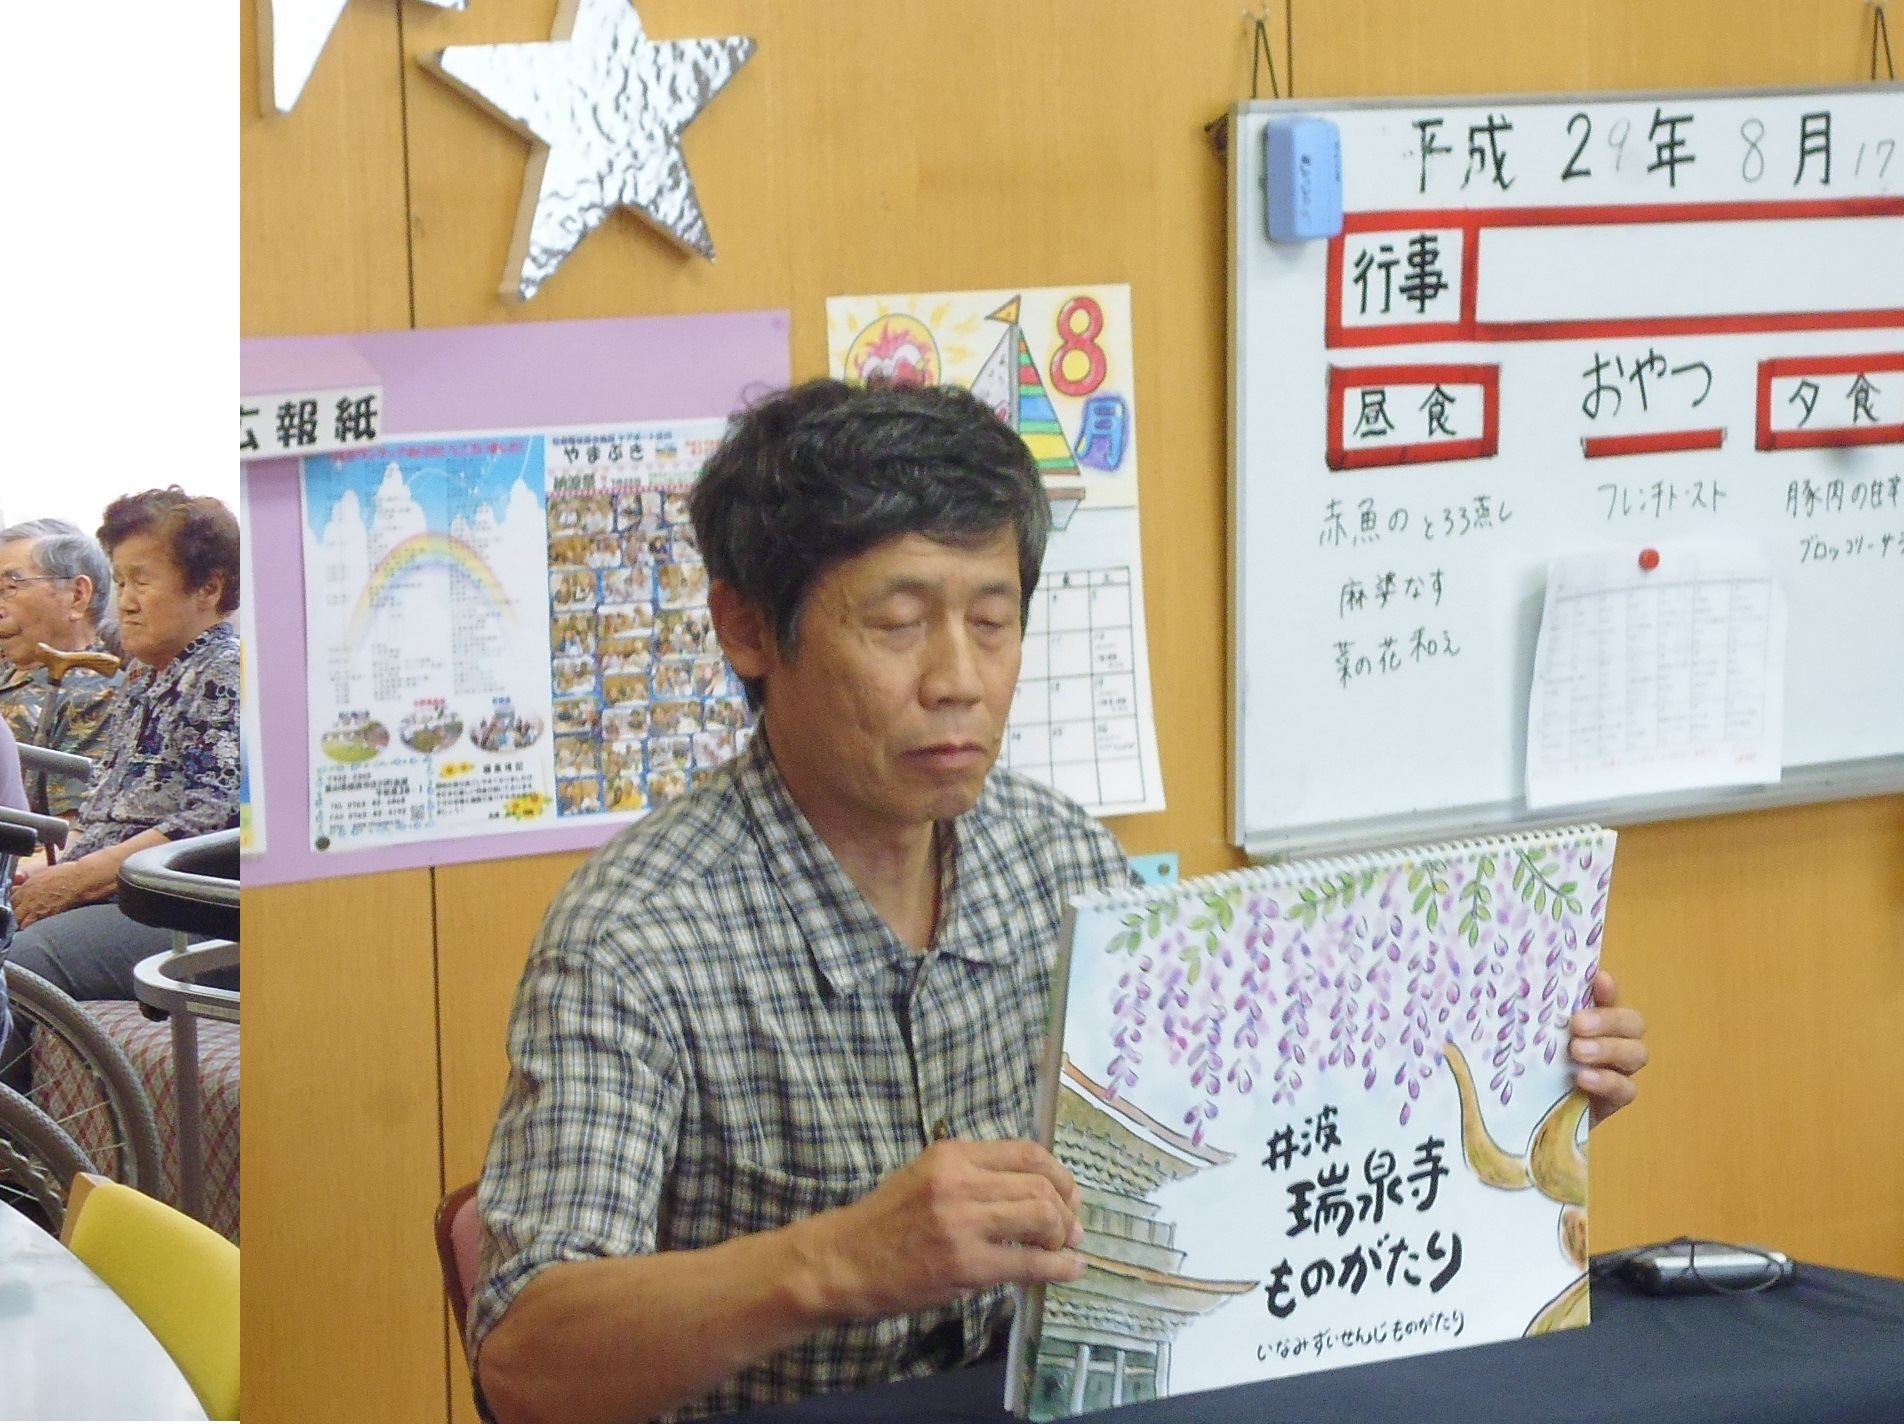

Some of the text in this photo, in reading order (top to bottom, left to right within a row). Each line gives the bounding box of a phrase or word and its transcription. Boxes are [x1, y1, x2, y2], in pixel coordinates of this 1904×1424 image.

[1410, 114, 1515, 193] 平成
[1352, 234, 1449, 314] 行事
[1050, 296, 1106, 396] 8
[1581, 348, 1712, 421] おやつ
[1076, 394, 1129, 471] 月
[1353, 385, 1458, 439] 昼食
[1788, 374, 1880, 427] 夕食
[1263, 1105, 1341, 1173] 井波
[1285, 1135, 1451, 1239] 瑞泉寺
[1265, 1230, 1463, 1318] ものがたり
